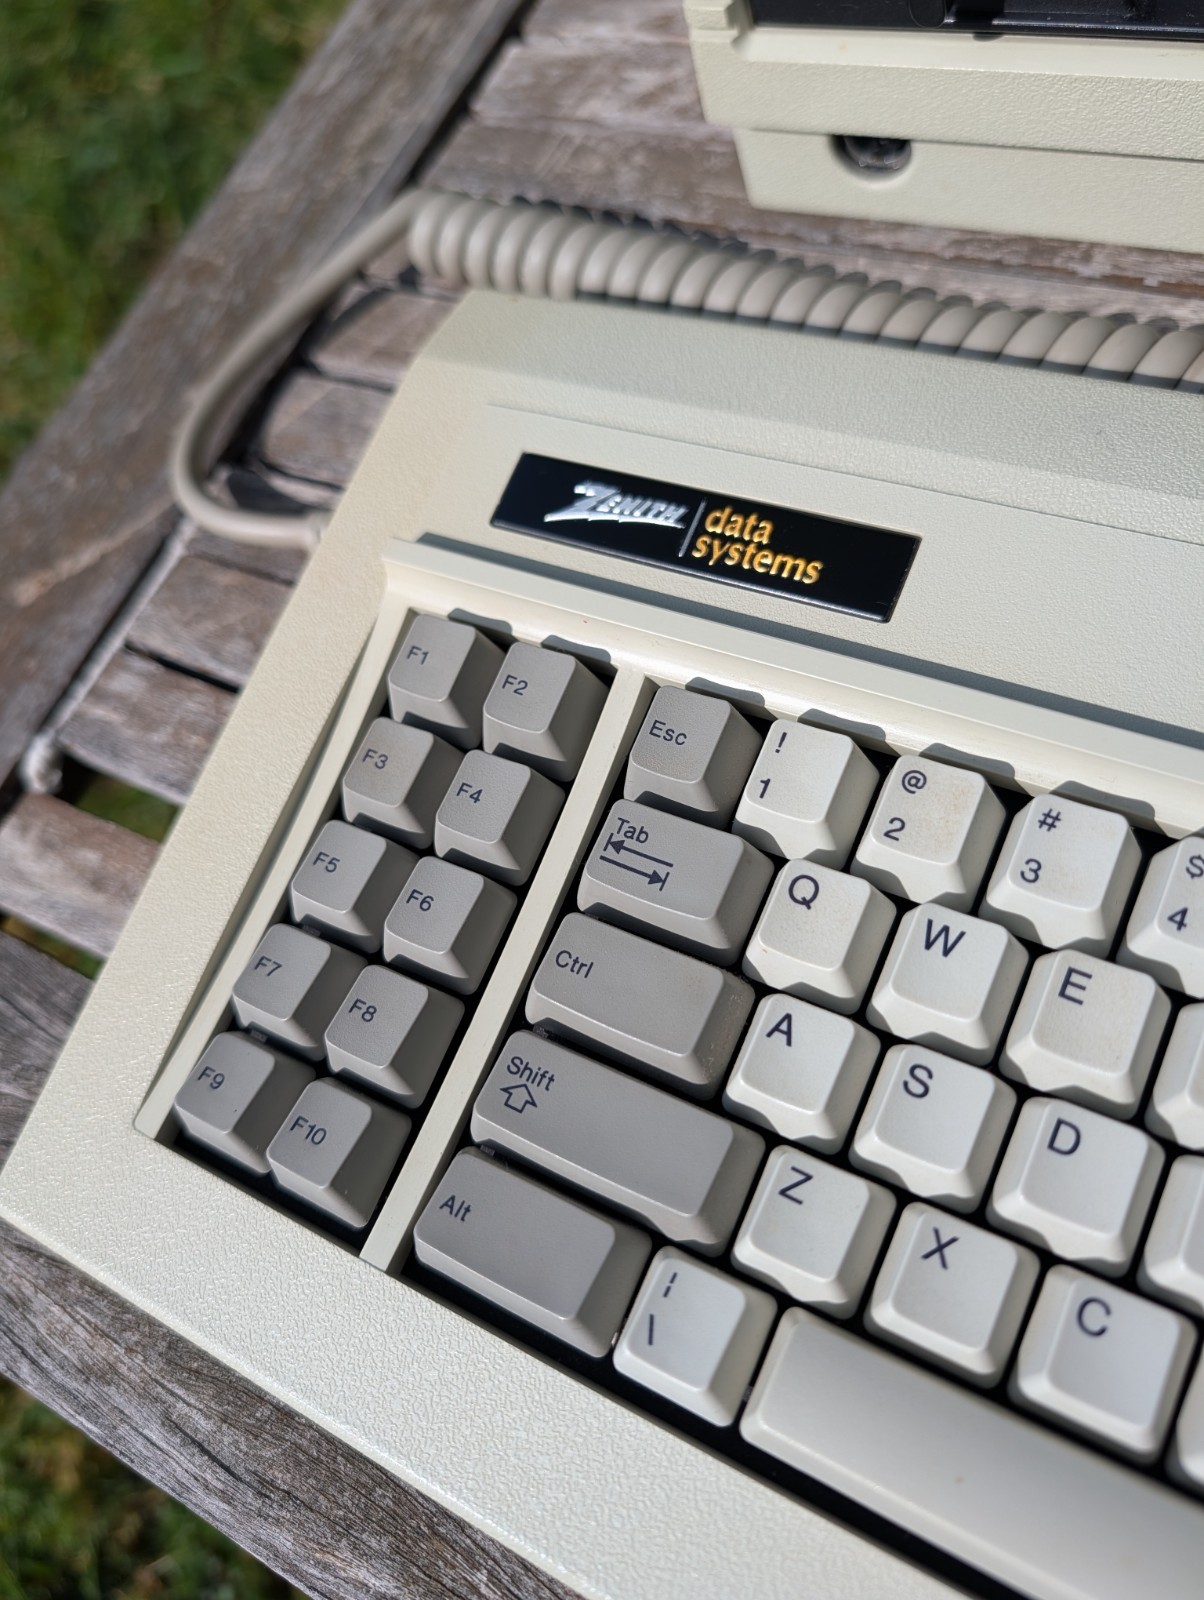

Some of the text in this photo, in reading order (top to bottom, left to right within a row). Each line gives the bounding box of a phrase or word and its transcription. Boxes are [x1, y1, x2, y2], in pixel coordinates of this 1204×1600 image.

[544, 480, 689, 527] ZENITH
[704, 506, 774, 545] data
[691, 535, 824, 584] systems
[406, 645, 429, 664] F1
[502, 674, 528, 695] F2
[649, 720, 687, 745] Esc
[775, 732, 787, 753] !
[362, 748, 388, 769] F3
[456, 782, 482, 803] F4
[760, 778, 770, 798] 1
[902, 770, 927, 794] @
[617, 817, 649, 843] Tab
[884, 817, 905, 841] 2
[1038, 809, 1061, 831] #
[313, 851, 340, 873] F5
[1020, 859, 1041, 883] 3
[1185, 854, 1204, 879] $
[406, 889, 434, 911] F6
[788, 875, 819, 910] Q
[1168, 908, 1188, 931] 4
[925, 919, 966, 957] W
[254, 956, 282, 976] F7
[556, 950, 593, 978] Ctrl
[1058, 967, 1092, 1005] E
[349, 998, 377, 1022] F8
[766, 1013, 792, 1047] A
[197, 1066, 225, 1089] F9
[507, 1056, 555, 1091] Shift
[903, 1064, 933, 1098] S
[290, 1116, 327, 1146] F10
[1047, 1118, 1081, 1155] D
[778, 1166, 813, 1205] Z
[439, 1195, 471, 1222] Alt
[921, 1228, 958, 1269] X
[1076, 1297, 1111, 1337] C
